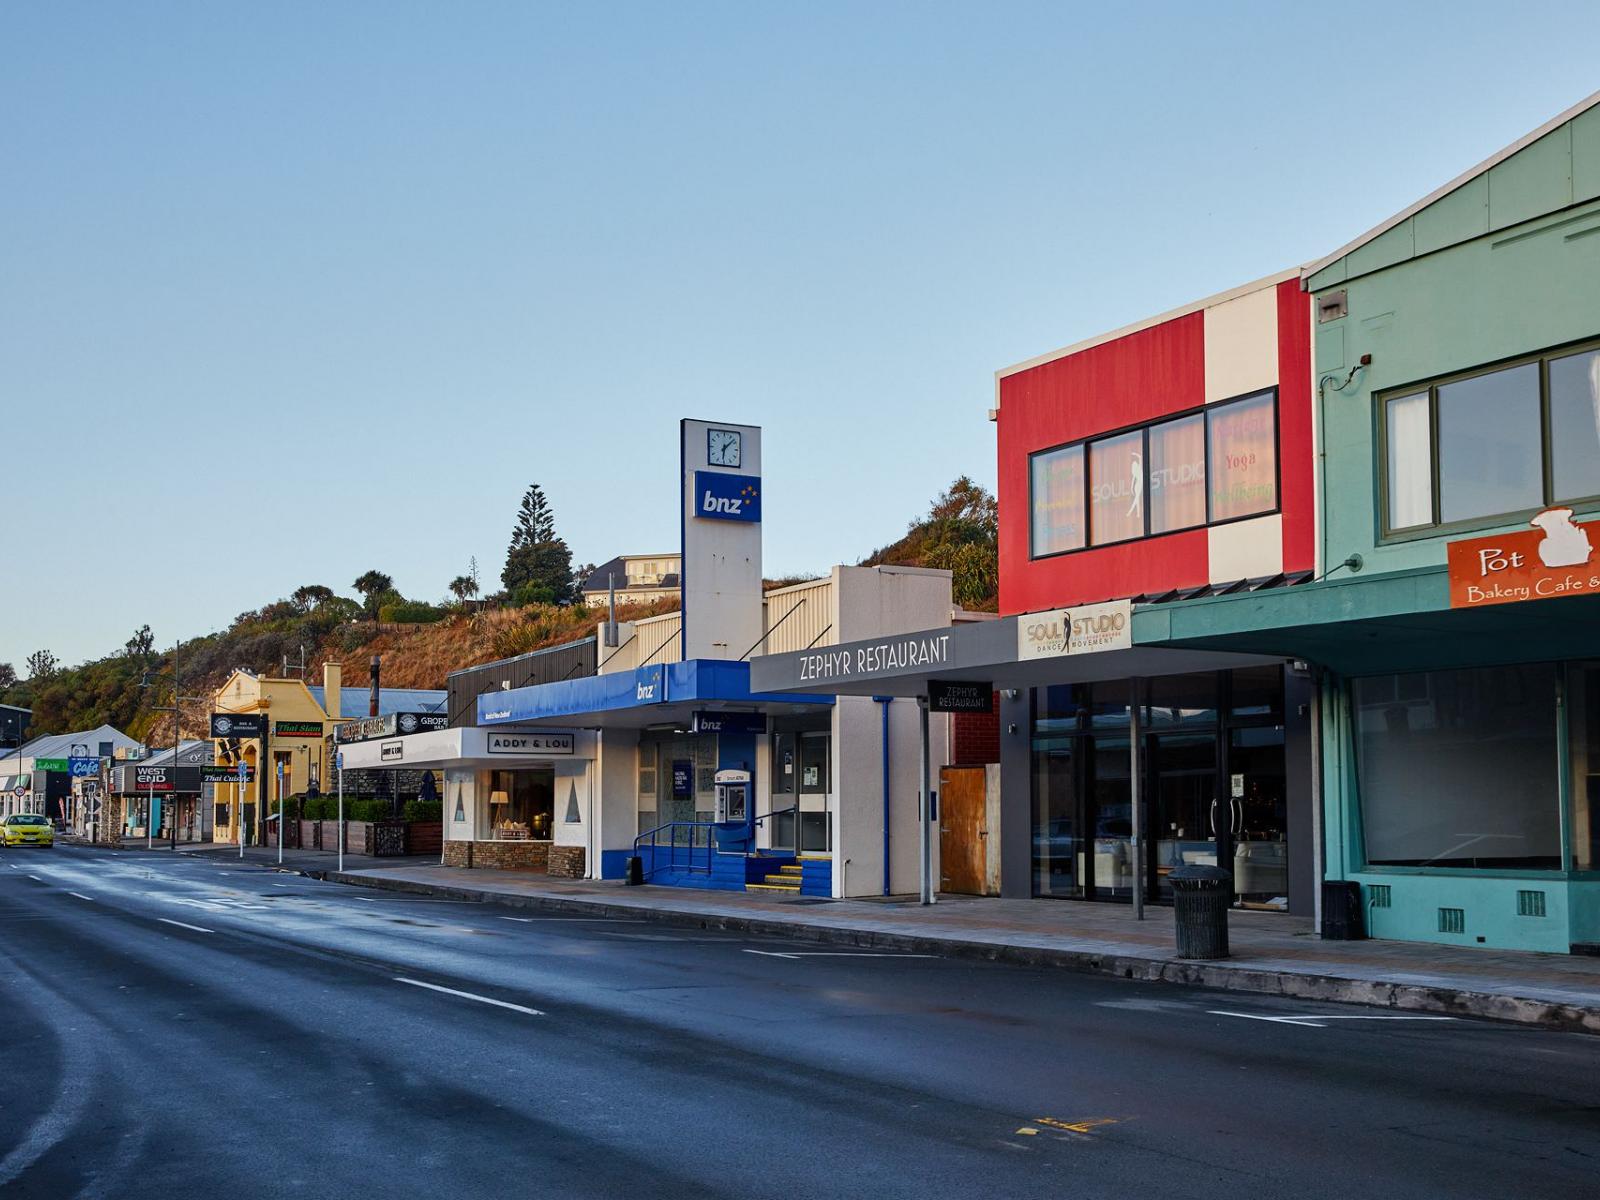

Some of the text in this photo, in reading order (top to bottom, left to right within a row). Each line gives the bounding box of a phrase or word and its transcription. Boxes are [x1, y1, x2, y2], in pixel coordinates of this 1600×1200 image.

[1226, 453, 1256, 472] Yoga
[1092, 480, 1131, 503] SOUL
[703, 490, 742, 514] bnz
[1478, 548, 1525, 577] Pot
[1467, 584, 1530, 604] Bakery
[1535, 575, 1584, 596] Cafe
[1027, 622, 1062, 642] SOUL
[1073, 612, 1125, 636] STUDIO
[1037, 644, 1062, 653] DANCE
[1072, 637, 1114, 648] MOVEMENT
[800, 636, 949, 680] ZEPHYR RESTAURANT
[637, 682, 654, 700] bnz
[946, 686, 978, 697] ZEPHYR
[939, 697, 985, 708] RESTAURANT
[700, 718, 722, 730] bnz
[494, 739, 569, 748] ADDY & LOU
[73, 761, 98, 774] Cafe
[137, 767, 167, 775] WEST
[137, 775, 167, 783] END
